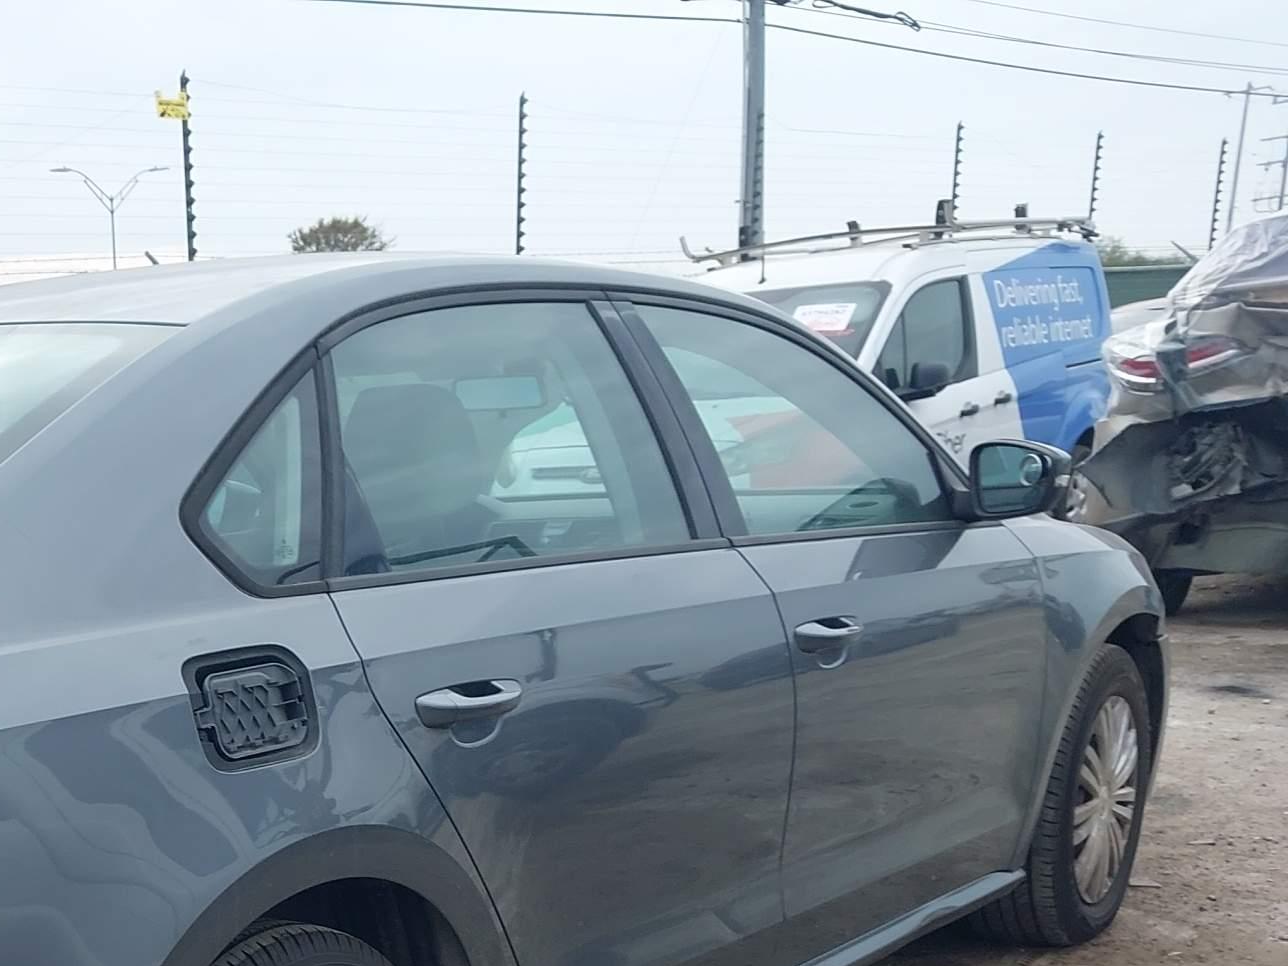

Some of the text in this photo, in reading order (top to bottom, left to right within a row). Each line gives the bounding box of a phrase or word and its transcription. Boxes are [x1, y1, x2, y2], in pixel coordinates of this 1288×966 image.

[994, 275, 1083, 311] Delivering fast,
[1002, 314, 1093, 347] reliable internet
